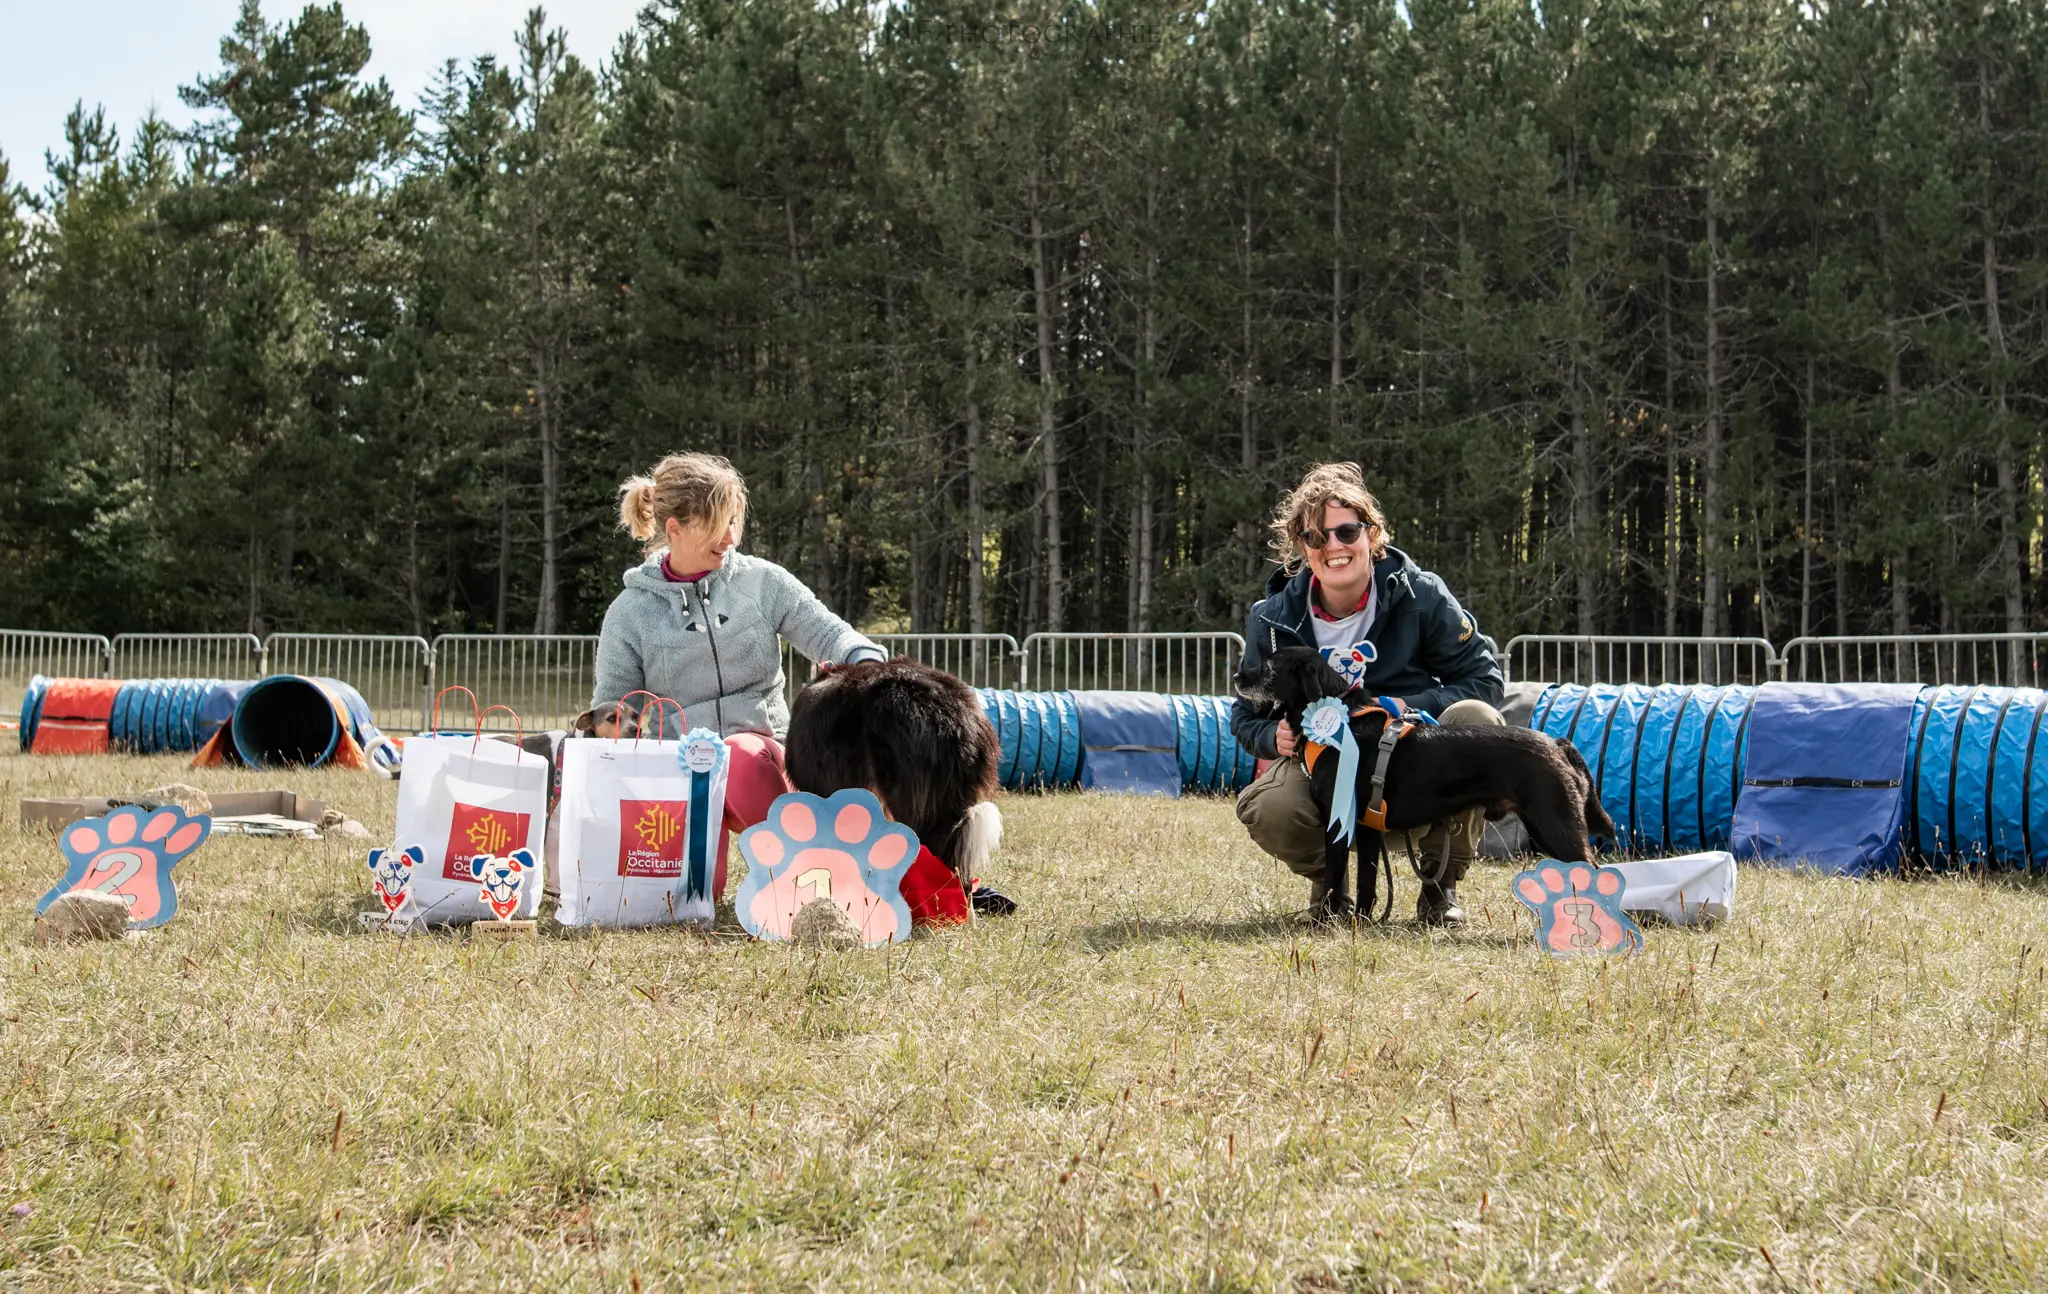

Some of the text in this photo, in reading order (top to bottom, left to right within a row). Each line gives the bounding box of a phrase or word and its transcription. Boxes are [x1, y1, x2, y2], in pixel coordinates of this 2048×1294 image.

[627, 857, 684, 869] Occitanie
[637, 850, 660, 858] Région
[95, 852, 142, 907] 2
[1563, 903, 1601, 948] 3
